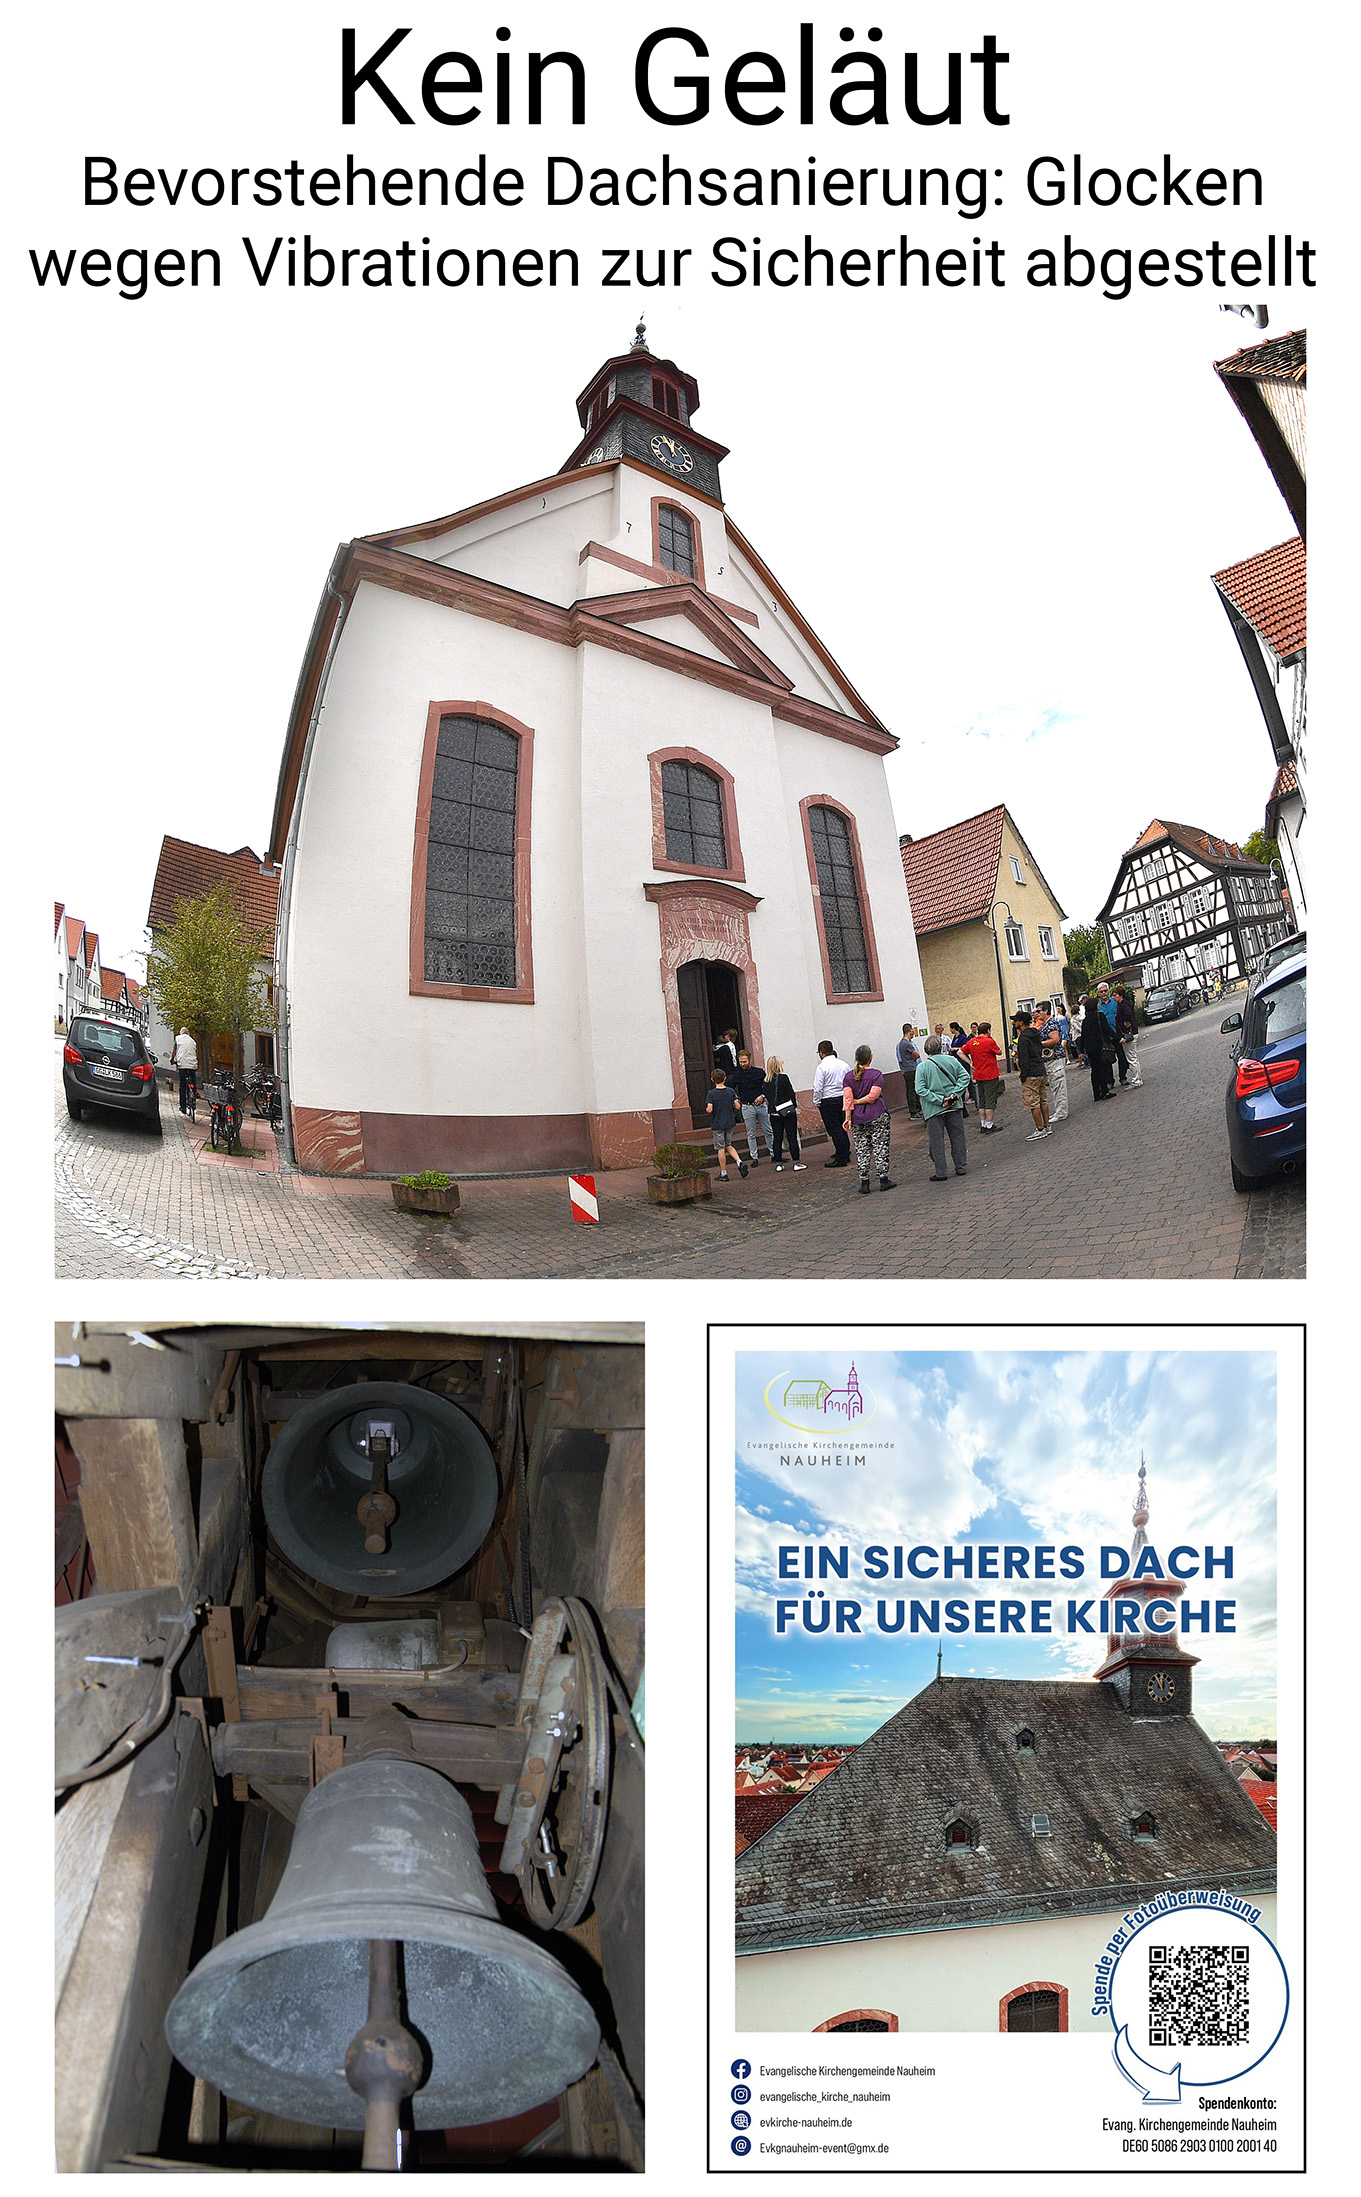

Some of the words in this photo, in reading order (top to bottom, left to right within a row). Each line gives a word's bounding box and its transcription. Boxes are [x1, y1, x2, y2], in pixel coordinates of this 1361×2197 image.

[746, 1441, 809, 1451] Evangelische
[812, 1441, 895, 1451] Kirchengemeinde
[780, 1455, 866, 1467] NAUHEIM
[778, 1546, 849, 1579] EIN
[864, 1545, 1085, 1579] SICHERES
[1100, 1545, 1234, 1579] DACH
[776, 1590, 862, 1633] FÜR
[877, 1599, 1052, 1633] UNSERE
[1067, 1599, 1236, 1633] KIRCHE
[1091, 1955, 1113, 2016] Spende
[1105, 1926, 1129, 1956] per
[1122, 1889, 1262, 1930] Fotoüberweisung
[759, 2065, 817, 2078] Evangelische
[818, 2065, 896, 2078] Kirchengemeinde
[896, 2065, 936, 2077] Nauheim
[759, 2091, 891, 2104] evangelische_kirche_nauheim
[1198, 2096, 1277, 2113] Spendenkonto:
[759, 2116, 853, 2128] evkirche-nauheim.de
[1102, 2117, 1137, 2134] Evang.
[1138, 2117, 1230, 2134] Kirchengemeinde
[1231, 2117, 1277, 2131] Nauheim
[759, 2142, 890, 2155] Evkgnauheim-event@gmx.de
[1122, 2138, 1149, 2153] DE60
[1151, 2138, 1178, 2153] 5086
[1179, 2138, 1207, 2153] 2903
[1208, 2138, 1234, 2153] 0100
[1236, 2138, 1261, 2153] 2001
[1262, 2138, 1278, 2153] 40
